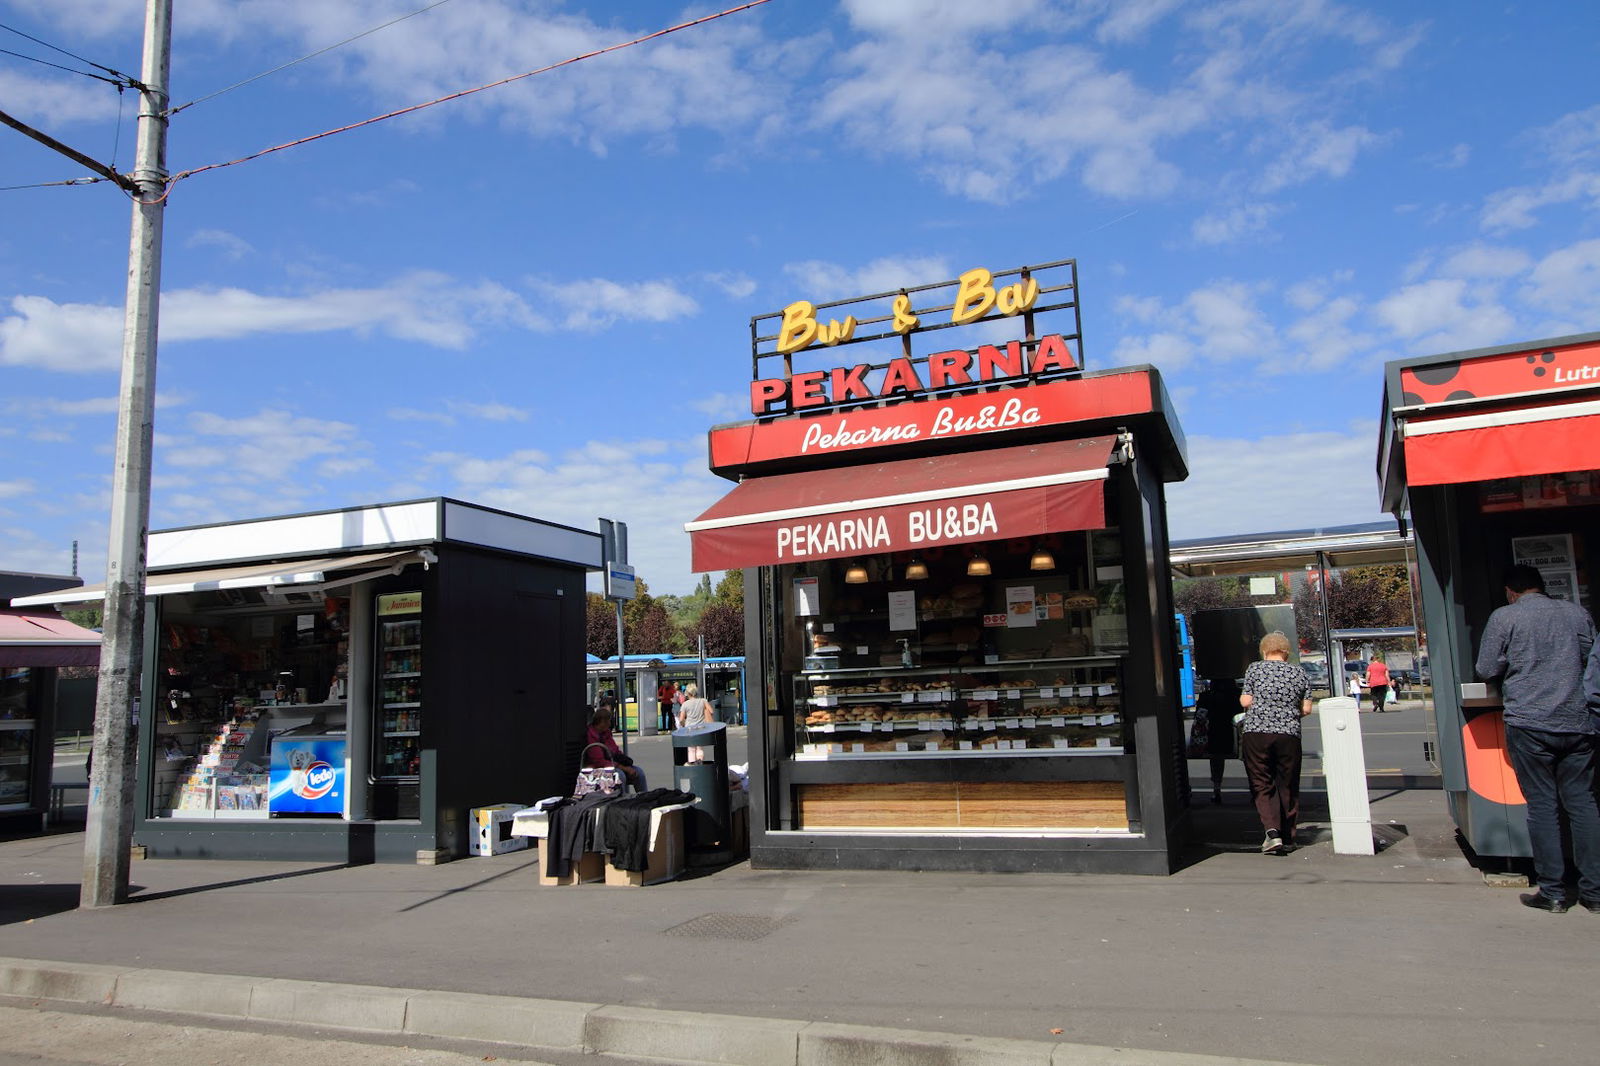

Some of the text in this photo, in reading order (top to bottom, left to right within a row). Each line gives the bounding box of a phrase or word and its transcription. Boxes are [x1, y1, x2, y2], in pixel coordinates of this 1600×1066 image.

[777, 267, 1040, 354] Bu & Ba
[750, 333, 1078, 415] PEKARNA
[801, 397, 1041, 453] Pekarna Bu&Ba
[777, 515, 891, 558] PEKARNA
[908, 501, 998, 544] BU&BA
